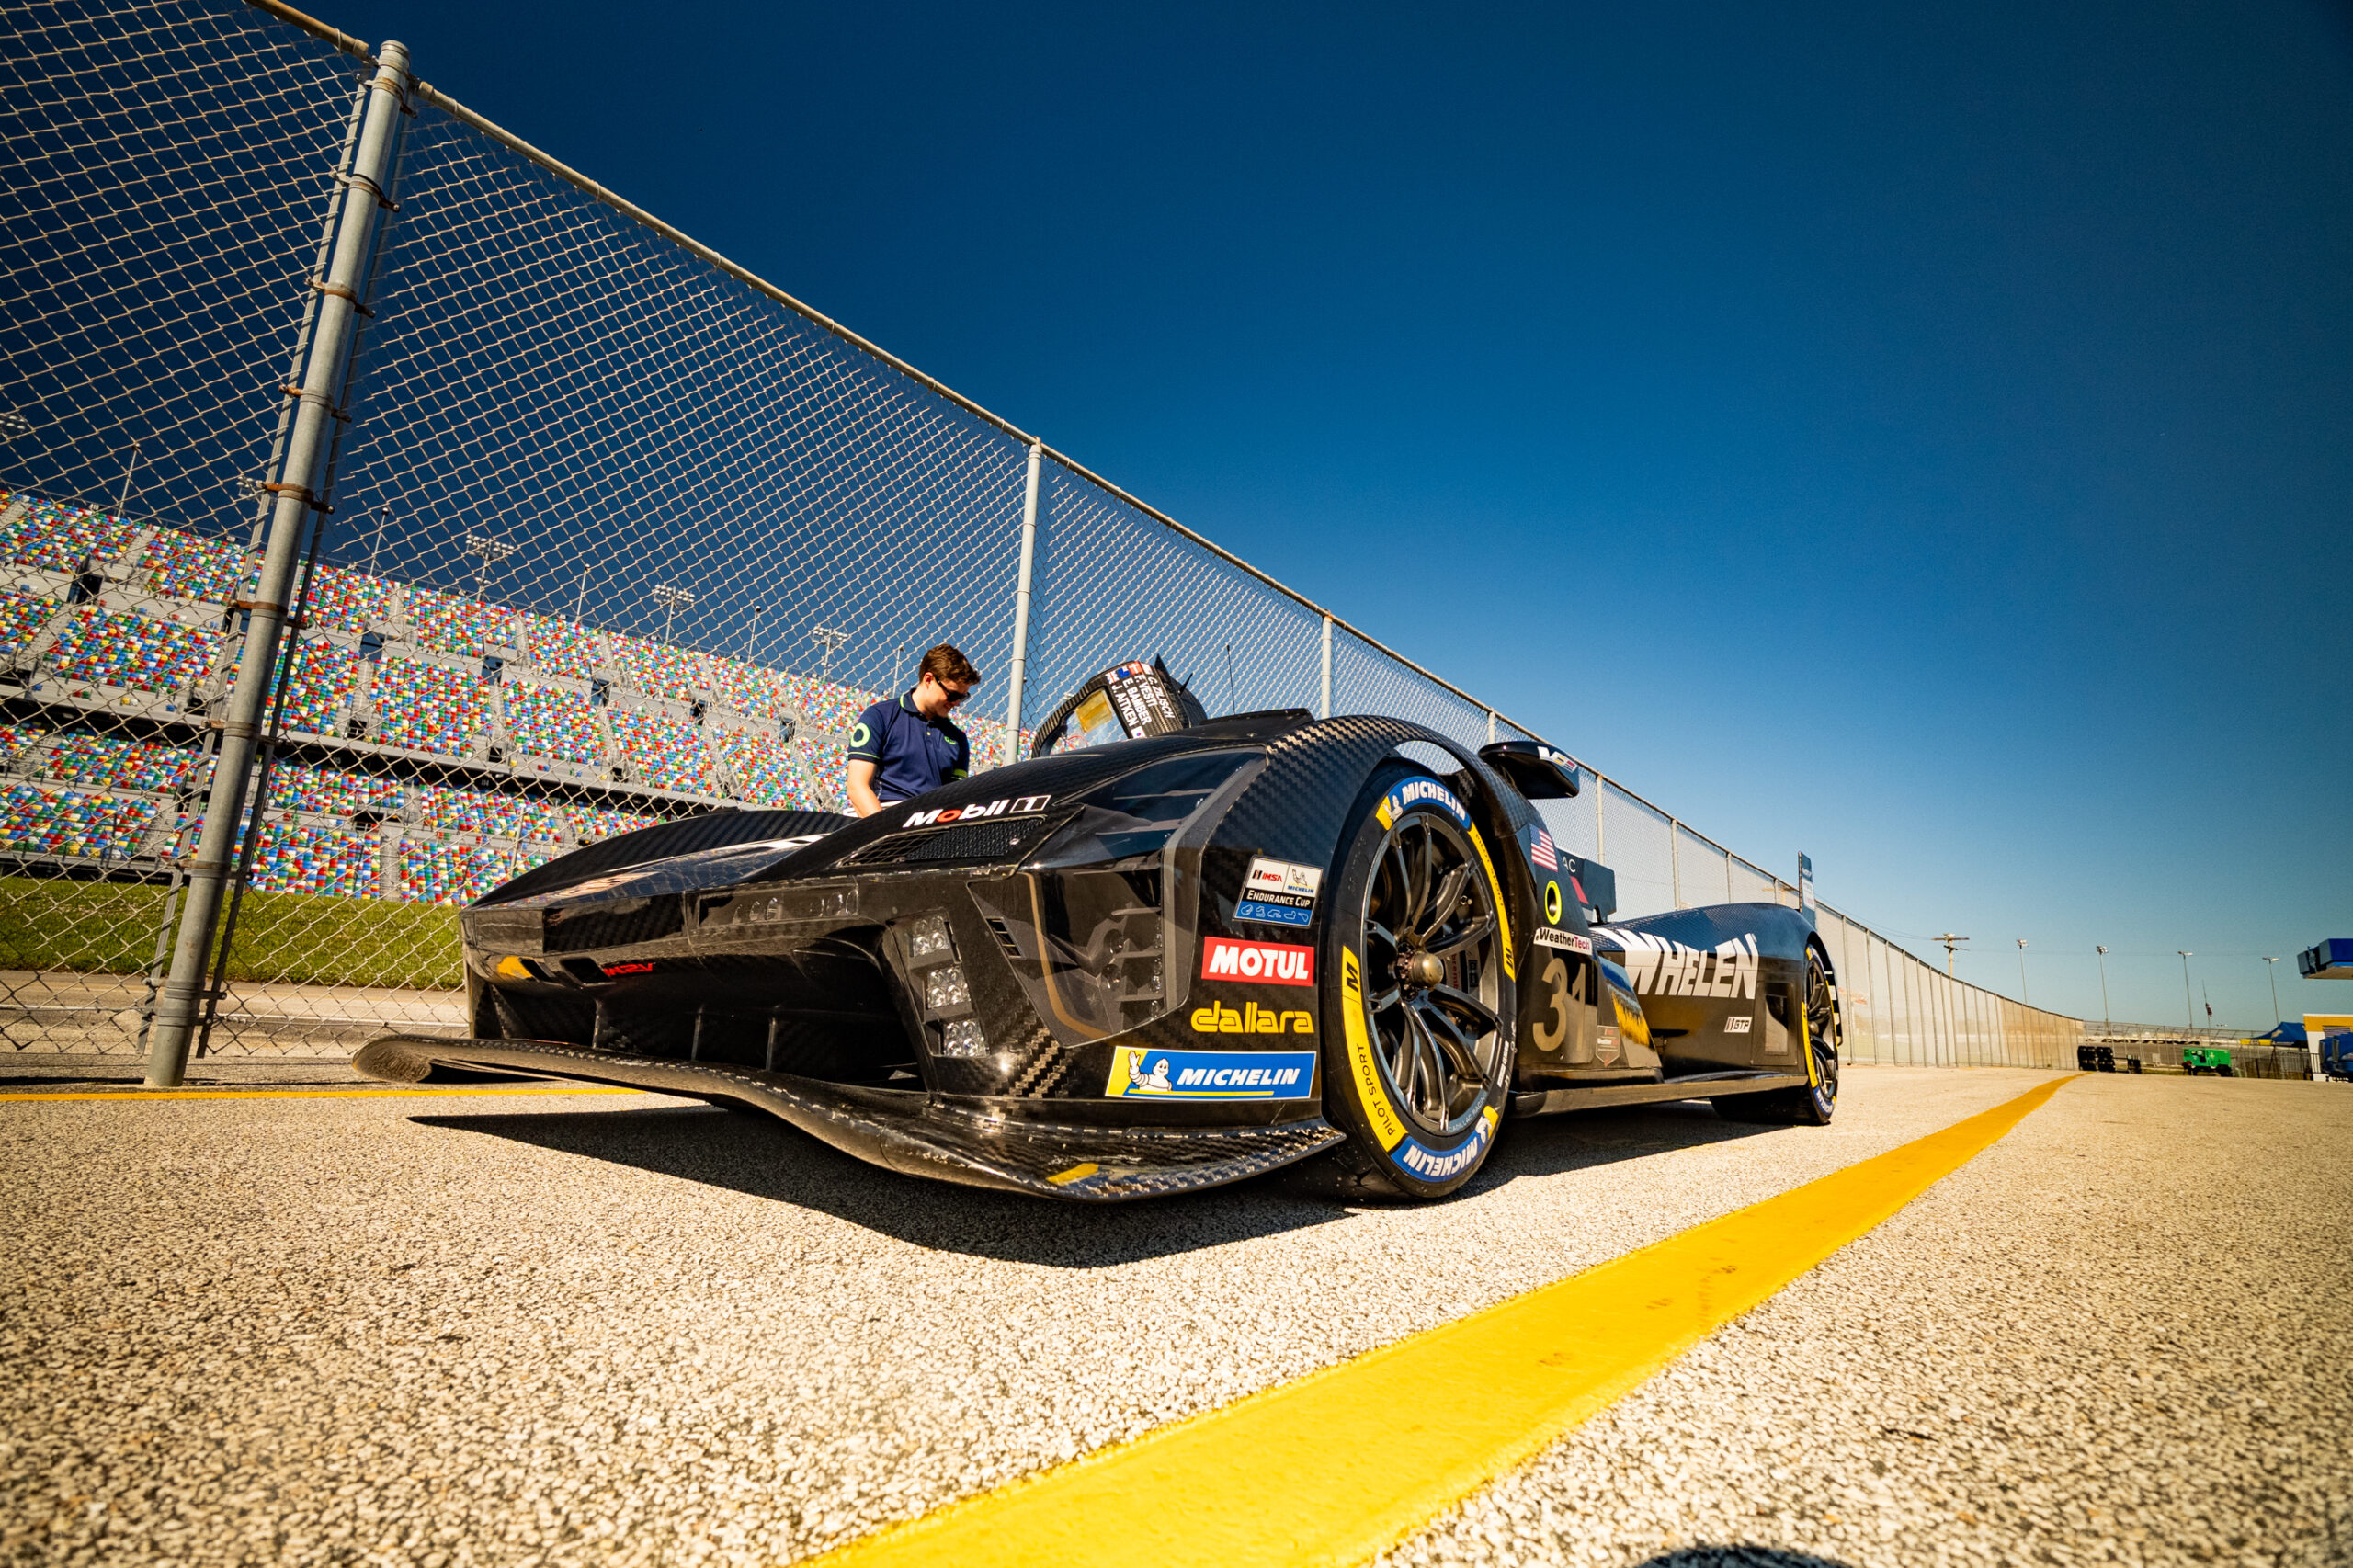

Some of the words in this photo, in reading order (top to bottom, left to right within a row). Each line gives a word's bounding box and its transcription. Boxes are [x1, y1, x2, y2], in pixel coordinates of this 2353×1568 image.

[1122, 677, 1134, 688] E.
[1138, 682, 1158, 708] VESTI
[1115, 692, 1141, 727] AITKEN
[1127, 686, 1153, 726] BAMBER
[903, 799, 1011, 828] Mobil
[1402, 780, 1466, 821] MICHELIN
[1261, 872, 1283, 882] IMSA
[1288, 885, 1314, 893] MICHELIN
[1246, 890, 1294, 906] ENDURANCE
[1295, 896, 1311, 907] CUP
[1540, 928, 1590, 950] WeatherTech
[1208, 945, 1309, 980] MOTUL
[1589, 927, 1759, 1000] WHELEN
[1191, 1000, 1314, 1033] dallara
[1533, 958, 1586, 1052] 31
[1733, 1020, 1750, 1029] GTP
[1176, 1068, 1301, 1085] MICHELIN
[1357, 1044, 1377, 1096] SPORT
[1372, 1101, 1396, 1136] PILOT
[1403, 1136, 1478, 1176] MICHELIN
